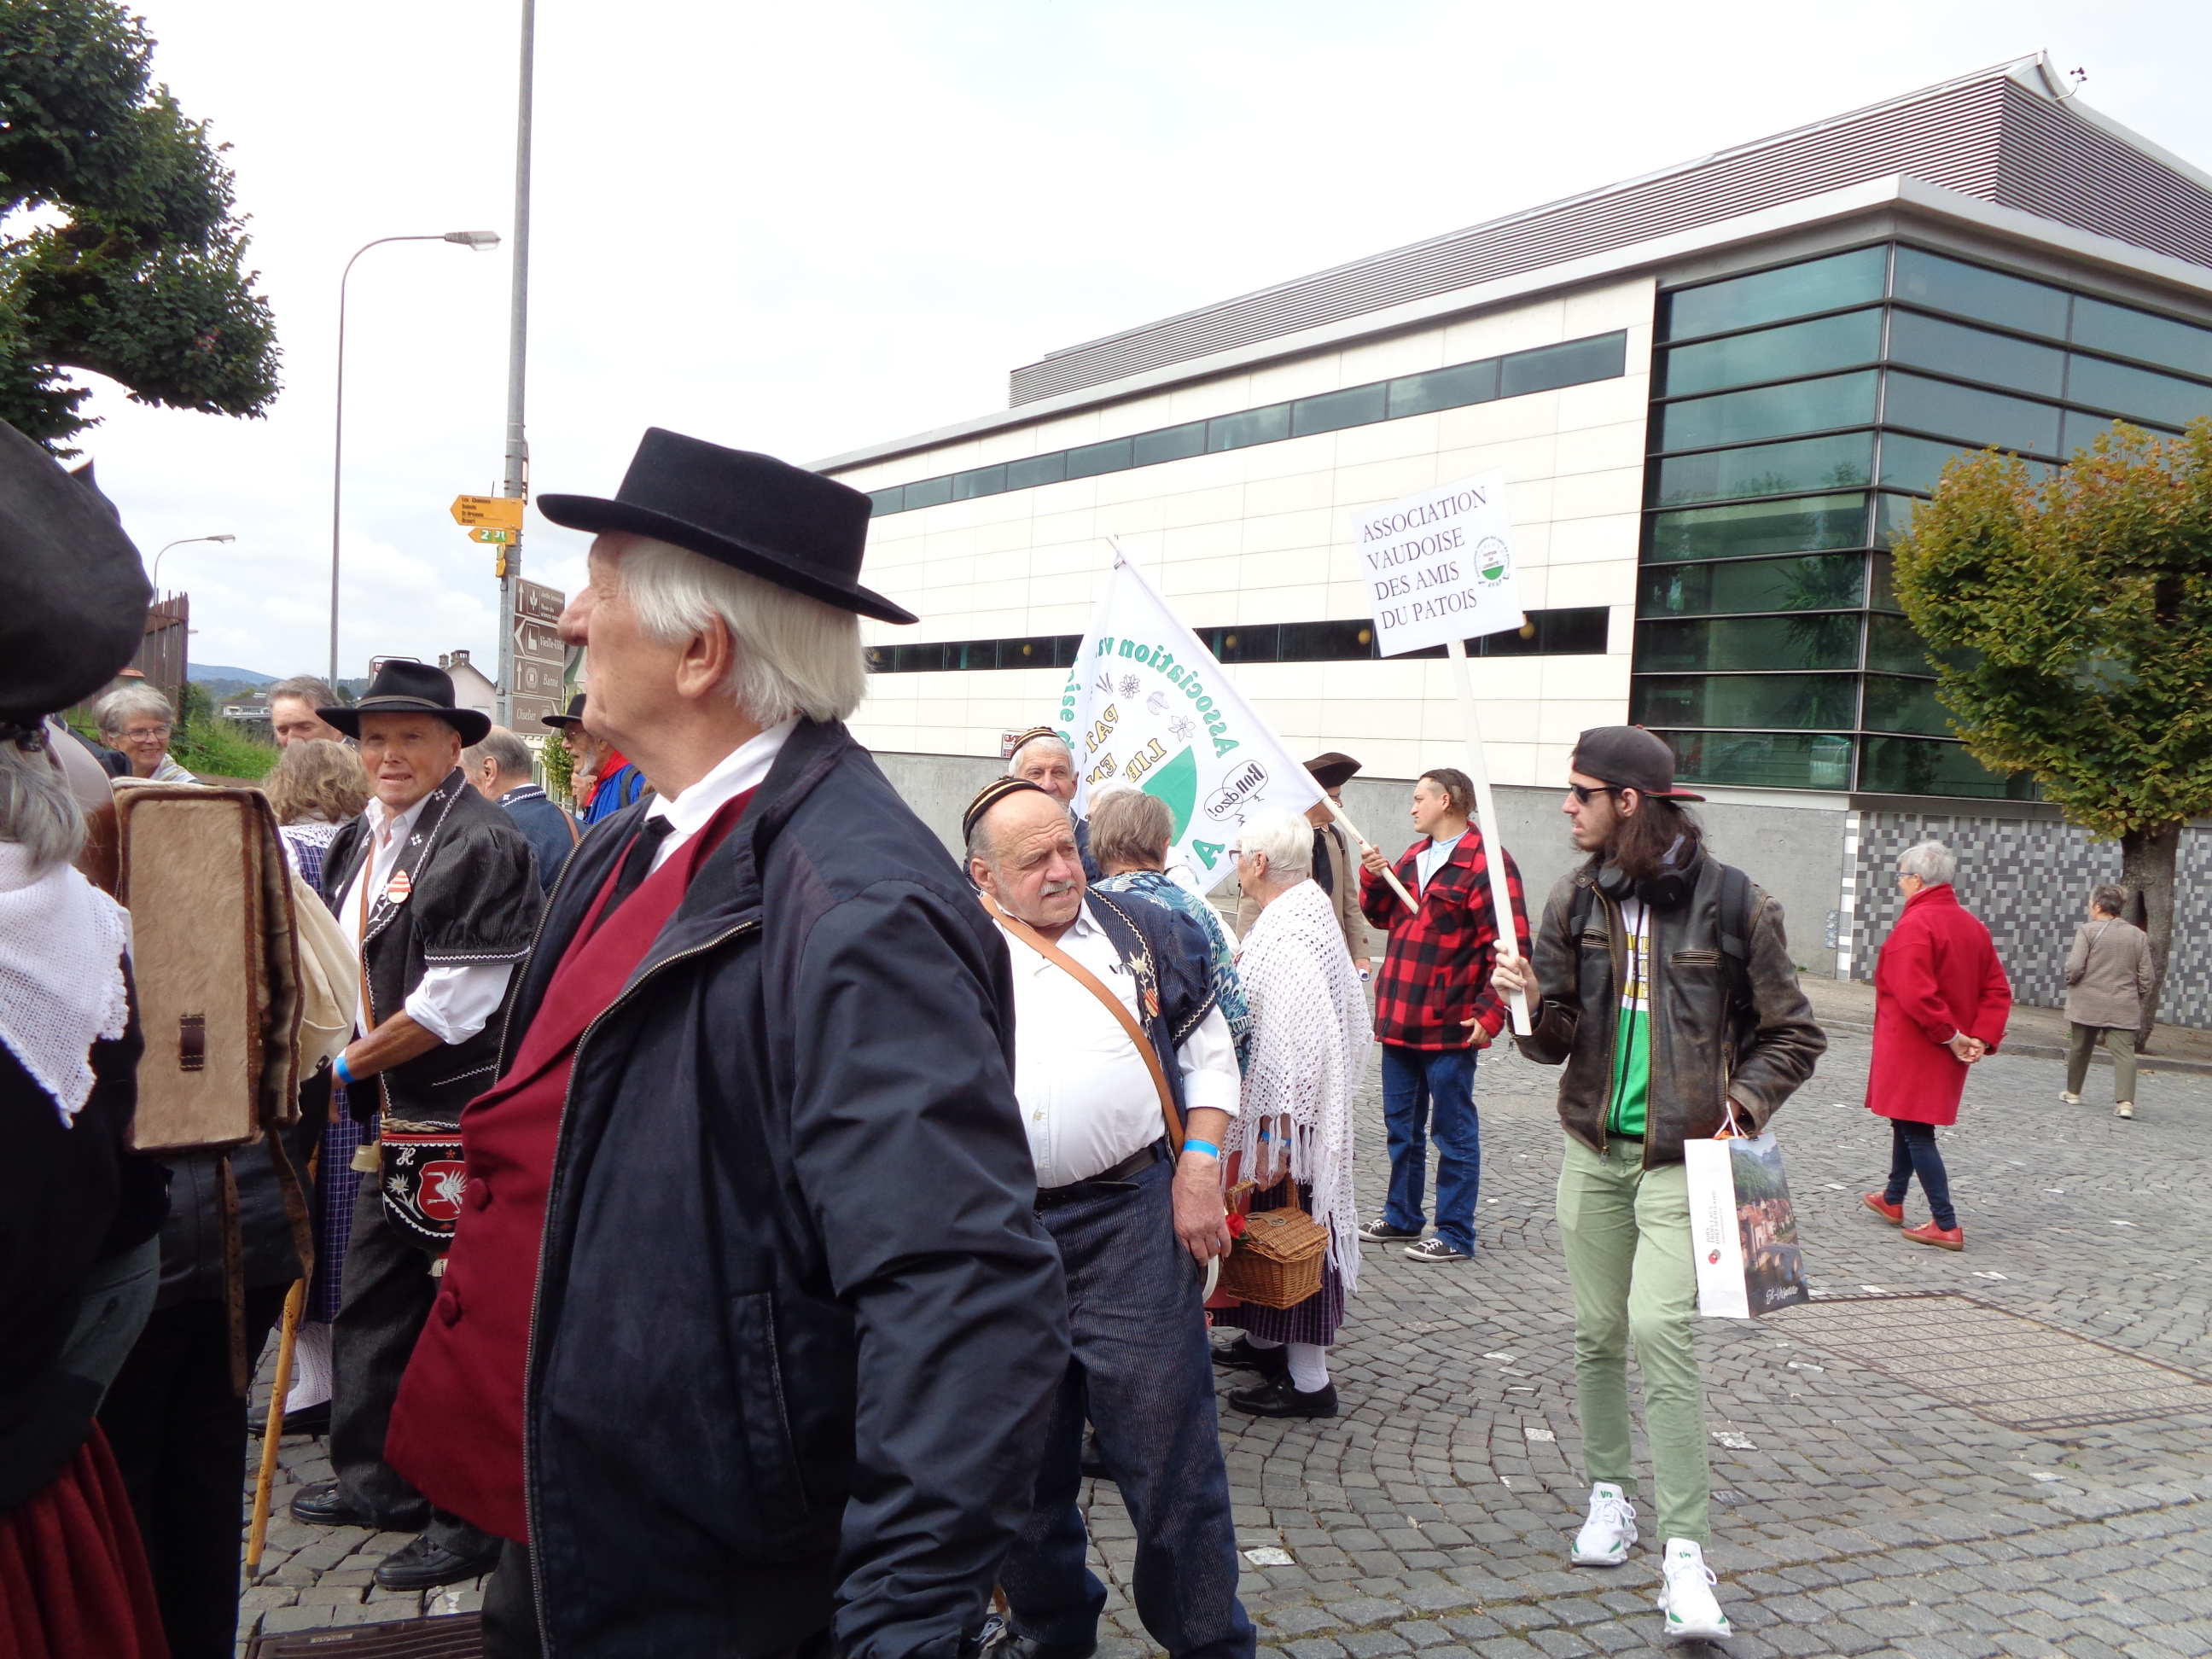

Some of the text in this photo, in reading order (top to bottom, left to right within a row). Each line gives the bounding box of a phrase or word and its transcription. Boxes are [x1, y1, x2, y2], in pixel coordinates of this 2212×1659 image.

[480, 529, 490, 540] 2
[1363, 486, 1487, 544] ASSOCIATION
[1367, 527, 1466, 571] VAUDOISE
[1374, 574, 1412, 602] DES
[1416, 561, 1460, 591] AMIS
[1381, 588, 1478, 630] DU PATOIS
[543, 673, 559, 688] Banné
